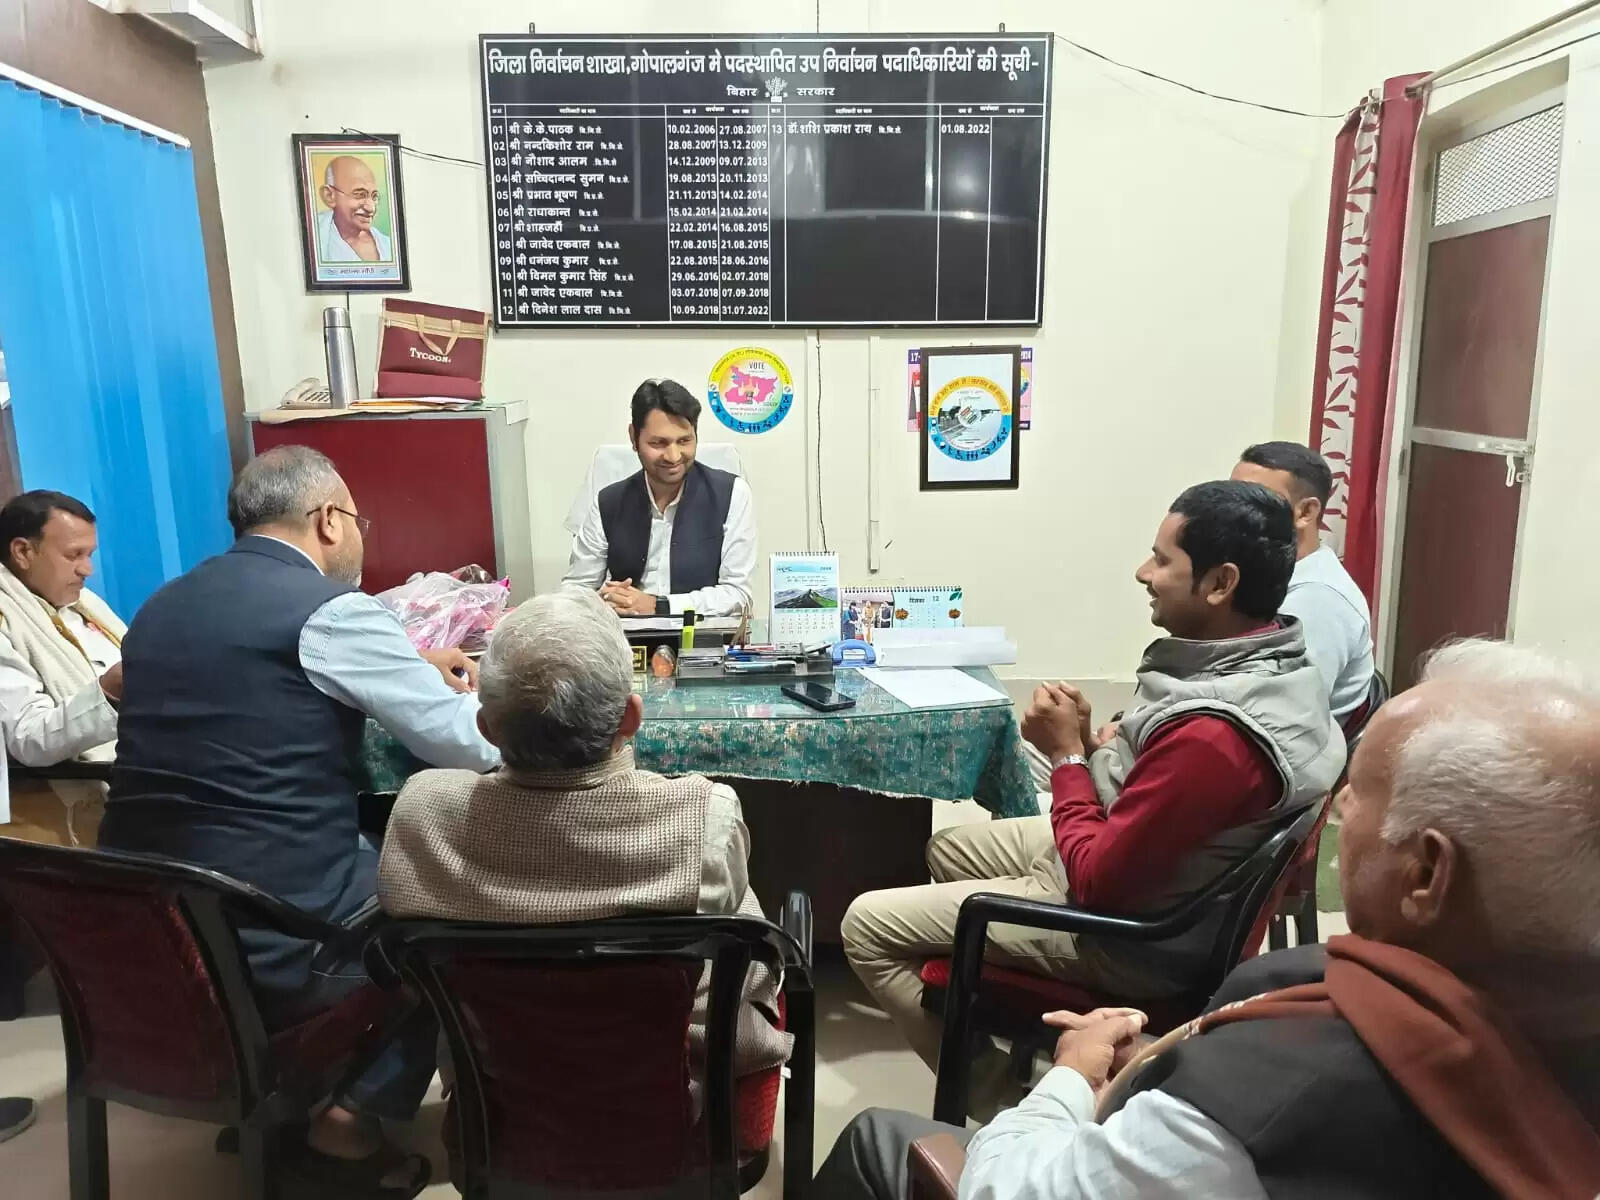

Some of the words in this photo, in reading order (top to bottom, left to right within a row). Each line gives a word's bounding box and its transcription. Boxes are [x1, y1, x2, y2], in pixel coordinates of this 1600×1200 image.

[489, 48, 526, 74] जिला
[530, 48, 584, 73] निर्वाचन
[725, 48, 796, 73] पदस्थापित
[799, 55, 820, 73] उप
[823, 48, 877, 72] निर्वाचन
[882, 47, 975, 72] पदाधिकारियों
[977, 47, 998, 71] की
[726, 85, 758, 96] बिहार
[796, 88, 835, 96] सरकार
[493, 126, 502, 134] 01
[509, 123, 520, 134] श्री
[668, 124, 715, 134] 10.02.2006
[720, 124, 766, 136] 27.08.2007
[772, 125, 782, 134] 13
[823, 124, 851, 133] प्रकाश
[855, 124, 872, 133] राय
[941, 124, 989, 133] 01.08.2022
[494, 141, 505, 151] 02
[510, 138, 520, 150] श्री
[523, 138, 572, 150] नन्दकिशोर
[576, 141, 593, 150] राम
[669, 140, 716, 149] 28.08.2007
[720, 140, 767, 149] 13.12.2009
[495, 157, 506, 166] 03
[511, 153, 521, 165] श्री
[525, 153, 554, 166] नौशाद
[559, 157, 587, 166] आलम
[669, 156, 715, 166] 14.12.2009
[719, 157, 767, 166] 09.07.2013
[496, 174, 508, 182] 04
[511, 171, 521, 183] श्री
[580, 174, 604, 186] सुमन
[669, 173, 716, 182] 19.08.2013
[720, 173, 768, 184] 20.11.2013
[497, 191, 508, 199] 05
[512, 187, 523, 199] श्री
[526, 190, 551, 199] प्रभात
[554, 191, 577, 202] भूषण
[668, 191, 716, 201] 21.11.2013
[720, 189, 768, 200] 14.02.2014
[498, 208, 509, 216] 06
[514, 205, 524, 216] श्री
[527, 208, 570, 216] राधाकान्त
[670, 207, 716, 216] 15.02.2014
[721, 207, 768, 216] 21.02.2014
[498, 224, 509, 232] 07
[514, 220, 525, 232] श्री
[671, 222, 718, 232] 22.02.2014
[721, 223, 767, 232] 16.08.2015
[499, 241, 510, 249] 08
[516, 237, 526, 249] श्री
[529, 237, 553, 249] जावेद
[556, 240, 590, 250] एकबाल
[669, 240, 717, 249] 17.08.2015
[721, 240, 768, 249] 21.08.2015
[500, 257, 511, 265] 09
[516, 253, 526, 265] श्री
[529, 254, 559, 264] धनंजय
[562, 256, 588, 268] कुमार
[671, 256, 717, 265] 22.08.2015
[722, 256, 768, 265] 28.06.2016
[502, 272, 511, 280] 10
[517, 269, 527, 280] श्री
[530, 268, 556, 280] विमल
[560, 272, 585, 284] कुमार
[589, 268, 607, 281] सिंह
[672, 270, 719, 281] 29.06.2016
[722, 272, 768, 280] 02.07.2018
[503, 289, 512, 297] 11
[518, 285, 528, 297] श्री
[531, 285, 555, 297] जावेद
[559, 288, 593, 297] एकबाल
[672, 288, 718, 297] 03.07.2018
[722, 288, 768, 297] 07.09.2018
[503, 306, 513, 314] 12
[519, 302, 529, 314] श्री
[532, 302, 557, 314] दिनेश
[560, 306, 580, 314] लाल
[584, 306, 602, 314] दास
[672, 306, 718, 314] 10.09.2018
[722, 306, 768, 314] 31.07.2022
